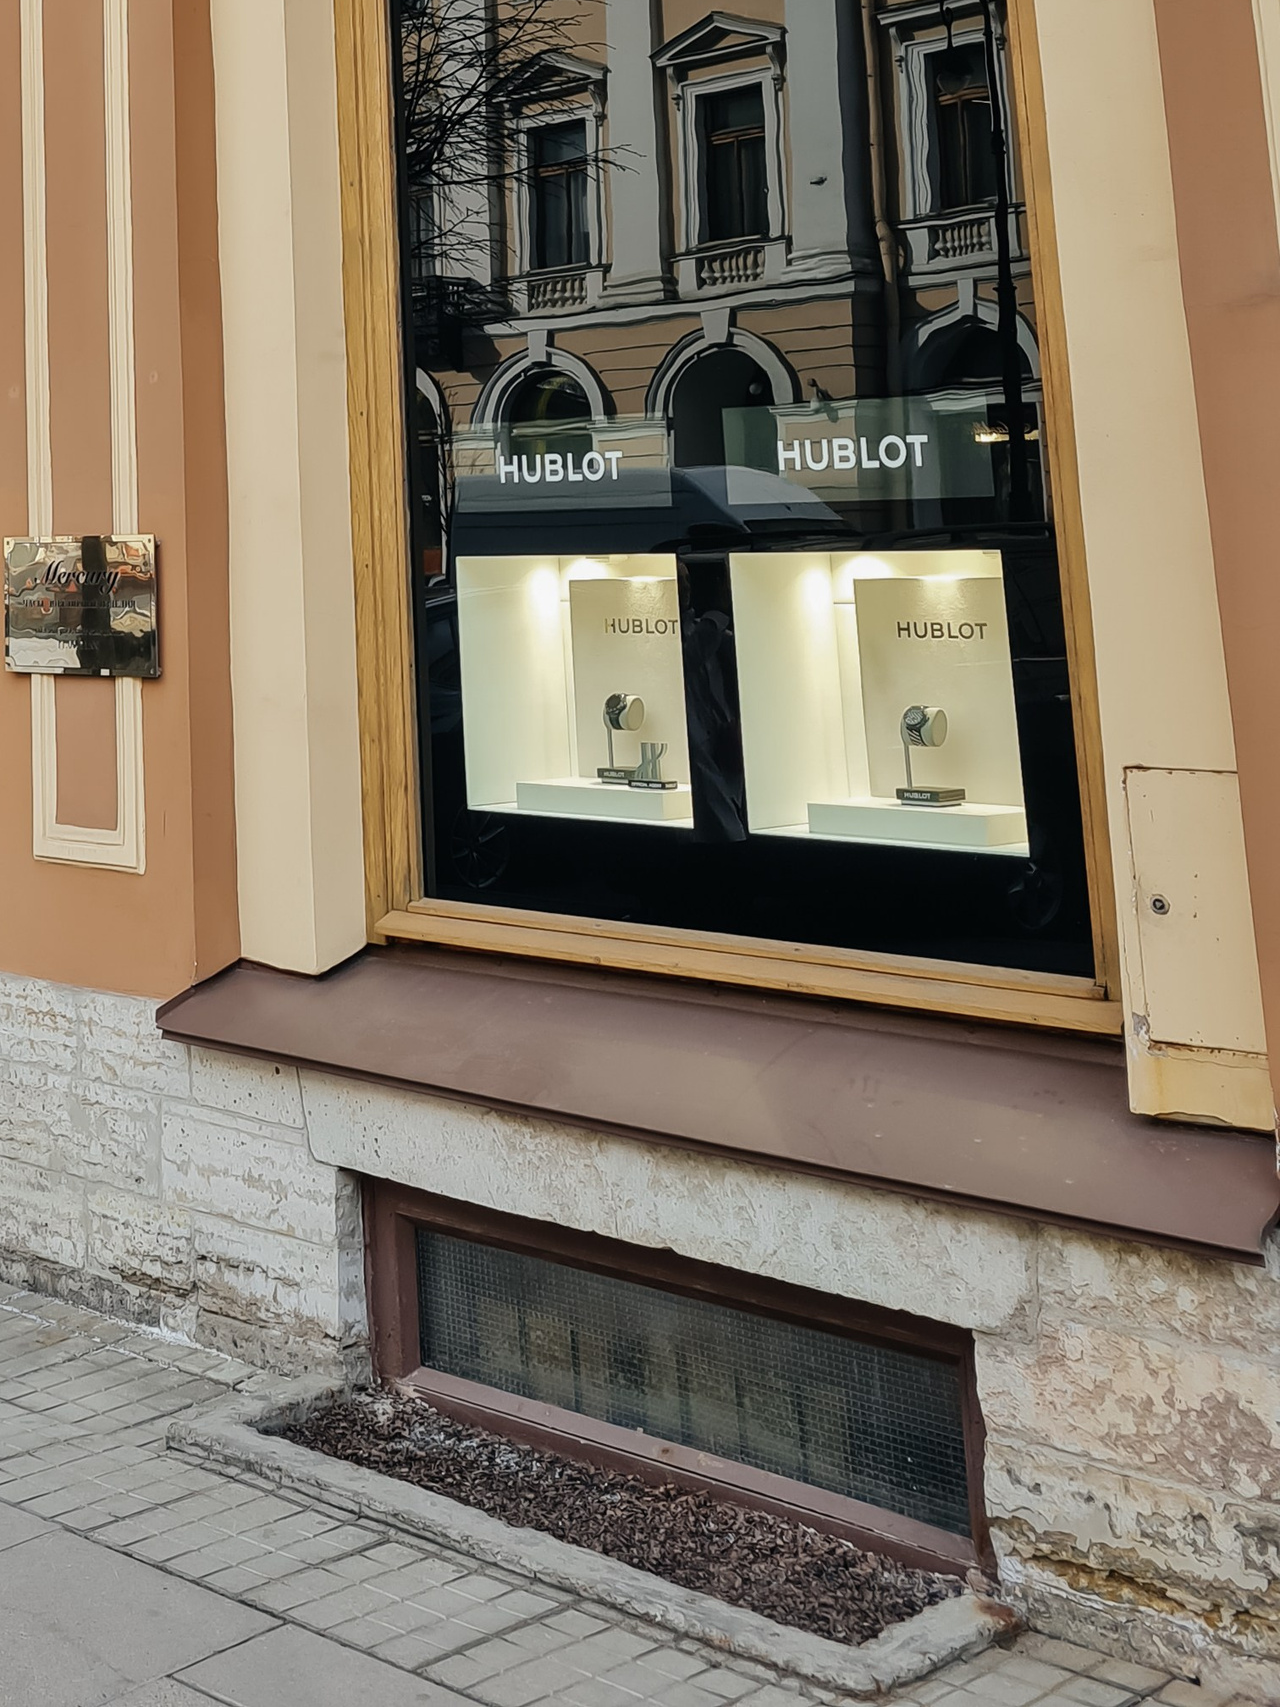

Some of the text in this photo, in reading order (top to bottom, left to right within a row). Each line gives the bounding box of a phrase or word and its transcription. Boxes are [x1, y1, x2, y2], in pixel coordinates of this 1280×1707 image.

[777, 434, 928, 472] HUBLOT
[498, 450, 623, 484] HUBLOT
[34, 560, 120, 594] Mercury
[604, 617, 679, 635] HUBLOT
[896, 620, 988, 640] HUBLOT
[903, 792, 931, 800] HUBLOT
